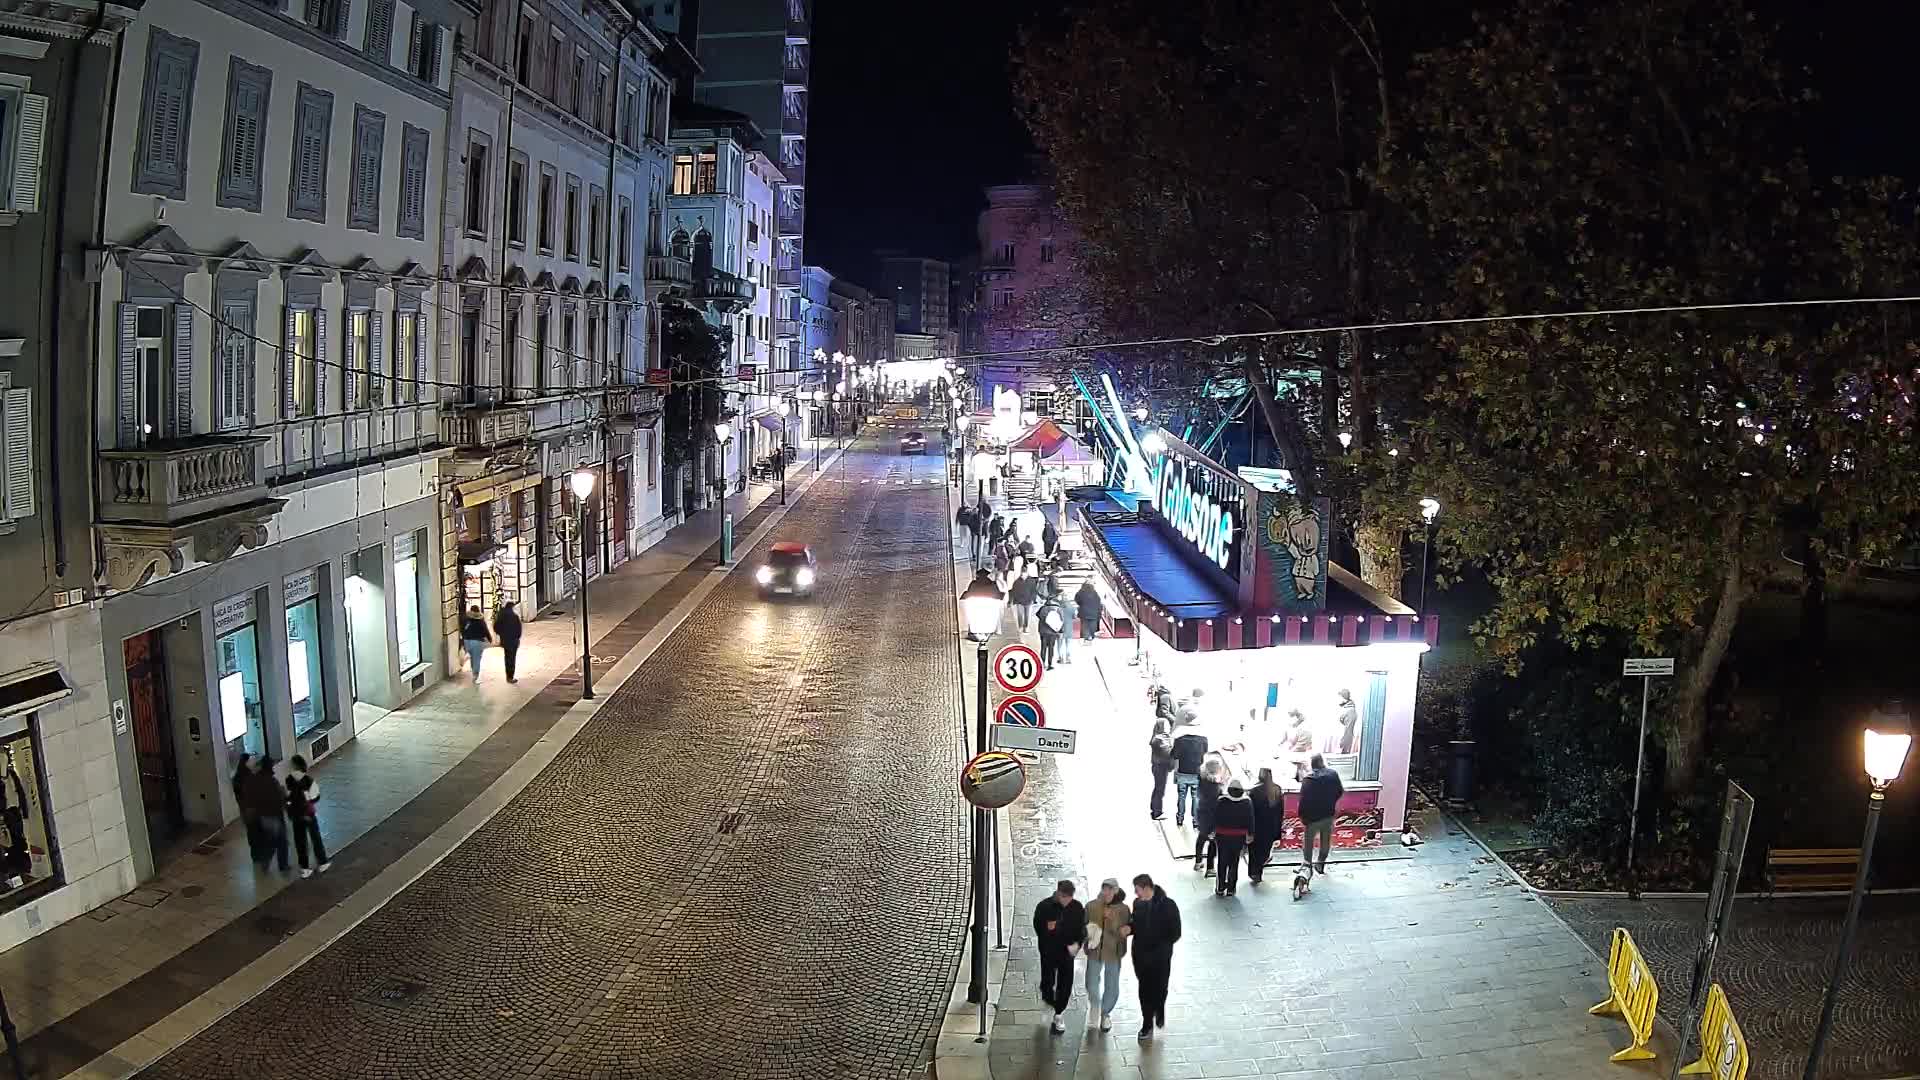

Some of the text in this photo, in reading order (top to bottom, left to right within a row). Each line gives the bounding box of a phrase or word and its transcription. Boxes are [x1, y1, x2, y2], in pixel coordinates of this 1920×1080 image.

[1162, 459, 1233, 569] Golosone
[1006, 658, 1032, 679] 30
[1038, 737, 1070, 749] Dante
